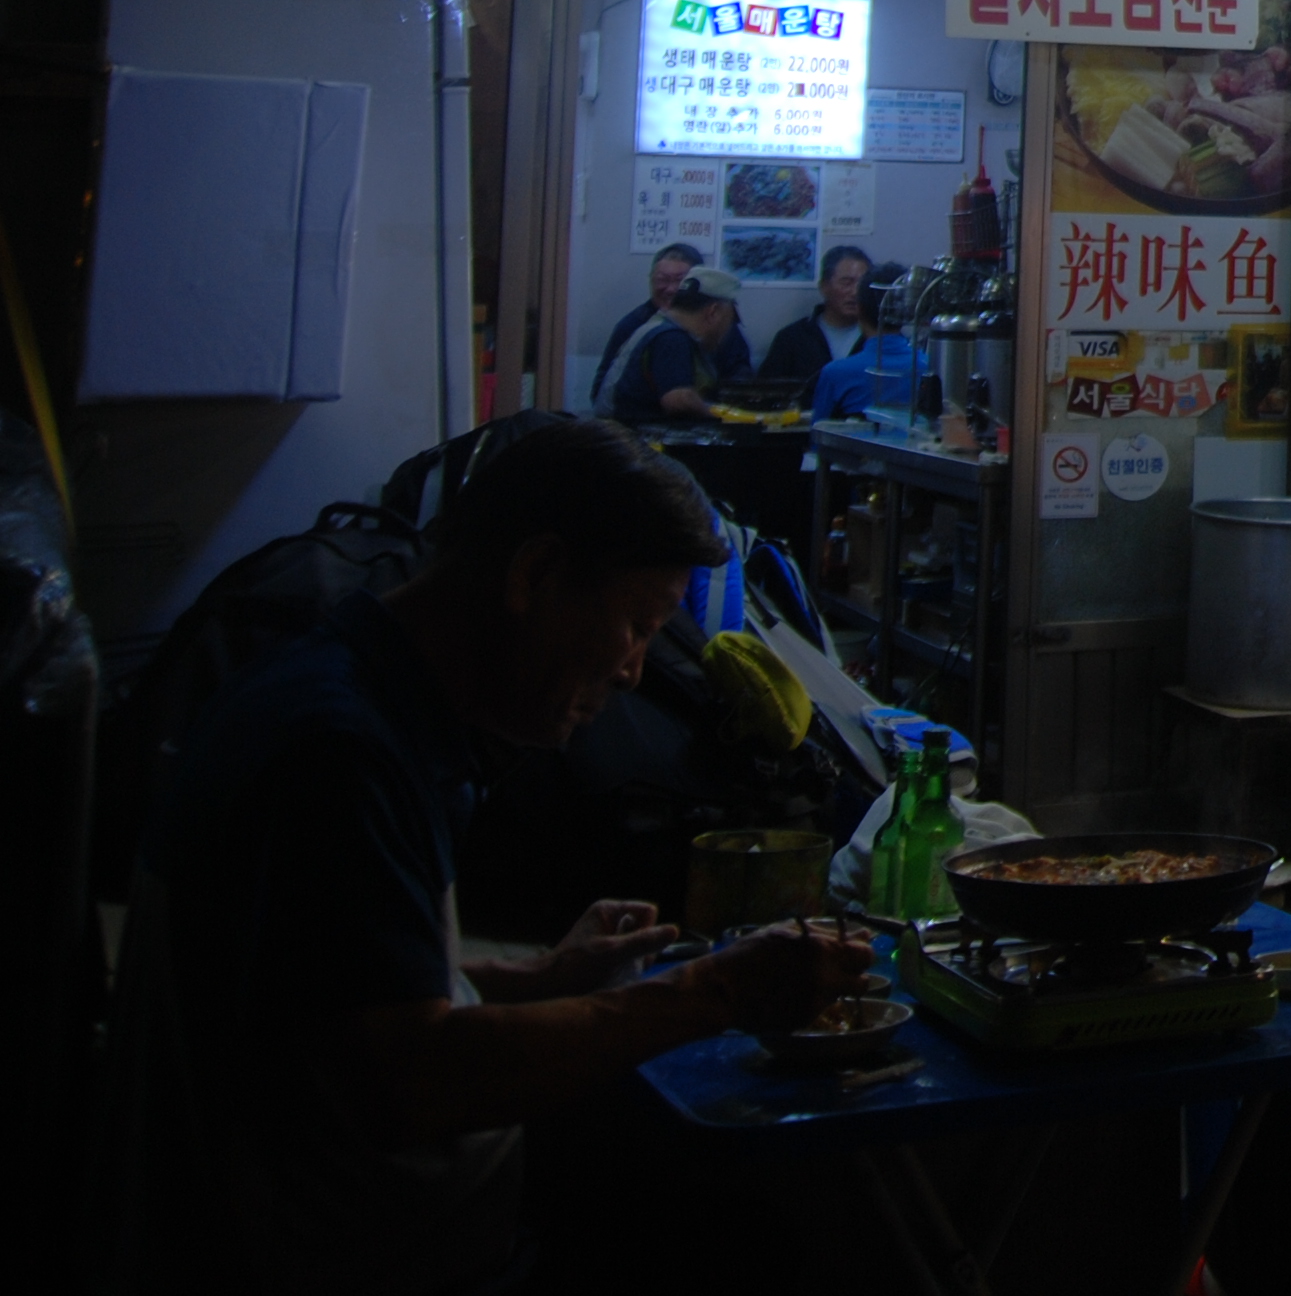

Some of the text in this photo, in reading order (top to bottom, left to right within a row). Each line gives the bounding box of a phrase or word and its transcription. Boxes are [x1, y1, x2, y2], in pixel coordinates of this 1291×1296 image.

[675, 2, 843, 39] 서울매운탕
[1057, 220, 1282, 322] 辣味鱼
[1078, 341, 1121, 357] VISA
